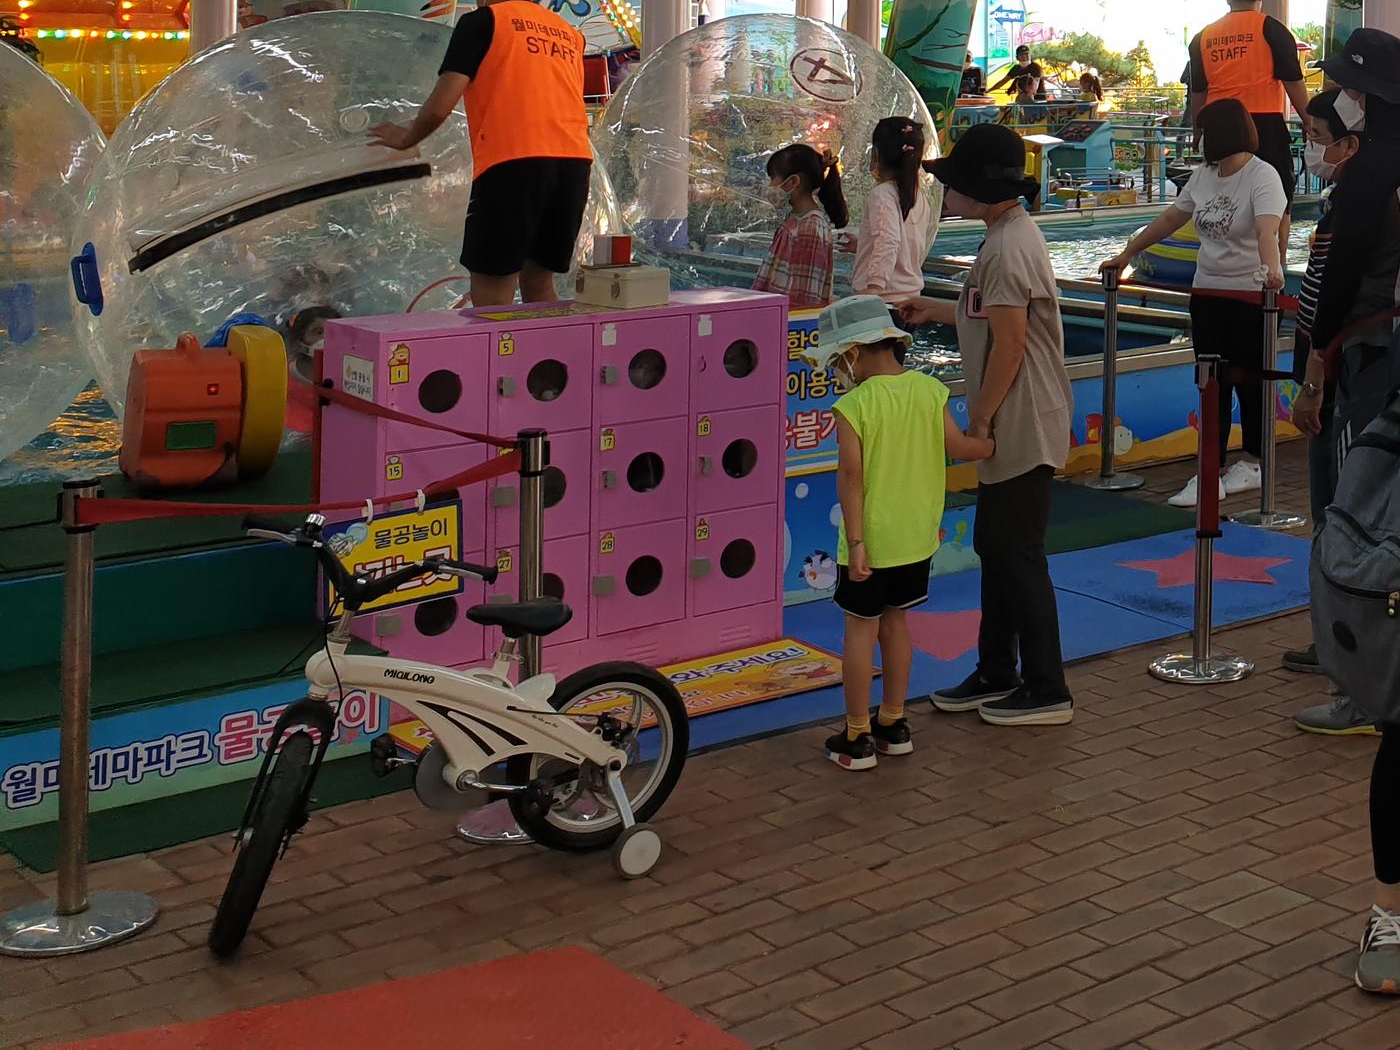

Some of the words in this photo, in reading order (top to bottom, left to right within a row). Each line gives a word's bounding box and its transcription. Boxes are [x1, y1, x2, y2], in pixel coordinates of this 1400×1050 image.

[526, 36, 575, 64] STAFF
[1210, 46, 1248, 63] STAFF
[502, 342, 510, 354] 5
[699, 422, 709, 433] 18
[603, 437, 613, 448] 17
[388, 466, 401, 477] 15
[374, 517, 449, 550] 물공놀이
[697, 527, 708, 538] 29
[601, 540, 613, 551] 28
[499, 558, 511, 569] 27
